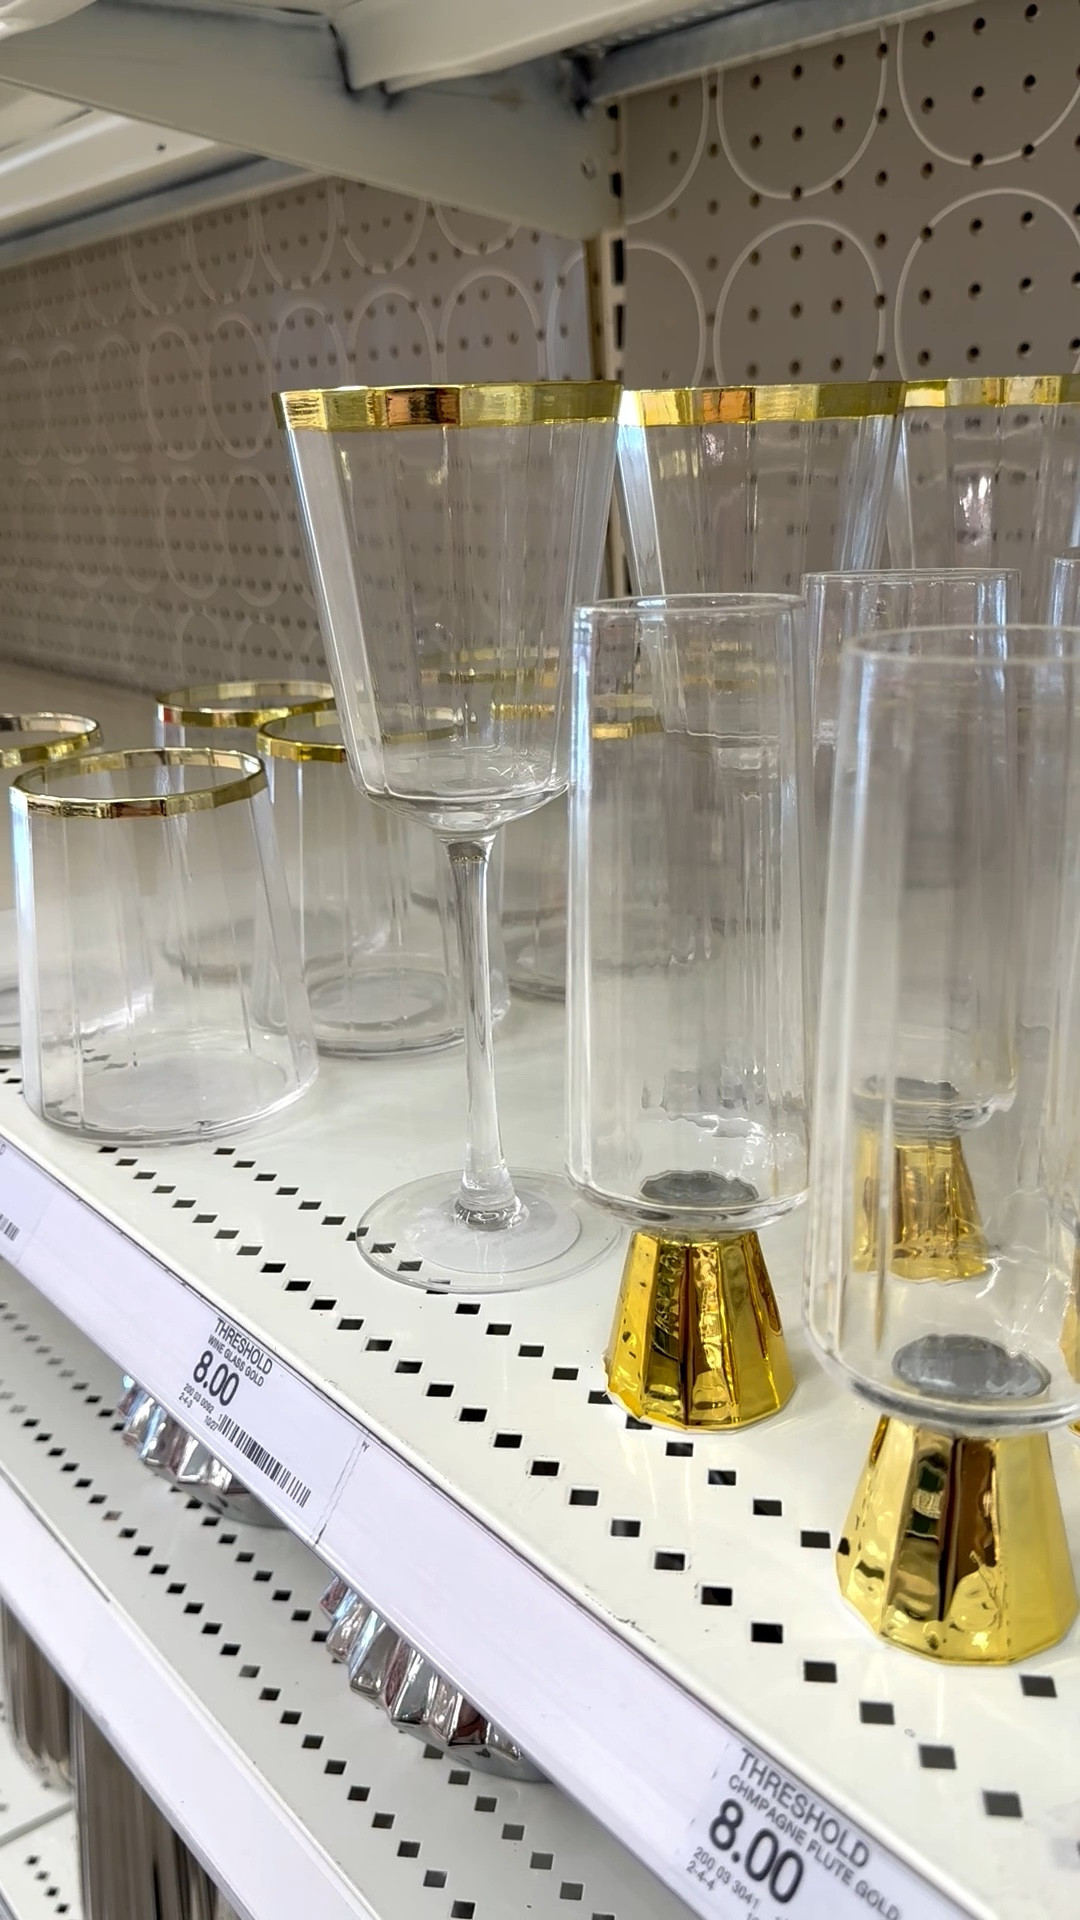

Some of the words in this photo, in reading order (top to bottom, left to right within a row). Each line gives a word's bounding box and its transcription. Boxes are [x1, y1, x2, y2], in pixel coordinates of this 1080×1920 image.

[207, 1333, 225, 1355] WINE
[223, 1346, 246, 1373] GLASS
[245, 1366, 264, 1387] GOLD
[214, 1317, 273, 1375] THRESHOLD
[183, 1383, 194, 1396] 200
[193, 1350, 240, 1406] 8.00
[738, 1747, 870, 1868] THRESHOLD
[686, 1860, 716, 1891] 2-4-4
[709, 1798, 805, 1904] 8.00
[728, 1773, 808, 1845] CHMPAGNE
[807, 1839, 855, 1884] FLUTE
[855, 1880, 902, 1920] GOLD
[693, 1846, 716, 1871] 200
[715, 1866, 731, 1886] 03
[731, 1879, 761, 1909] 3041
